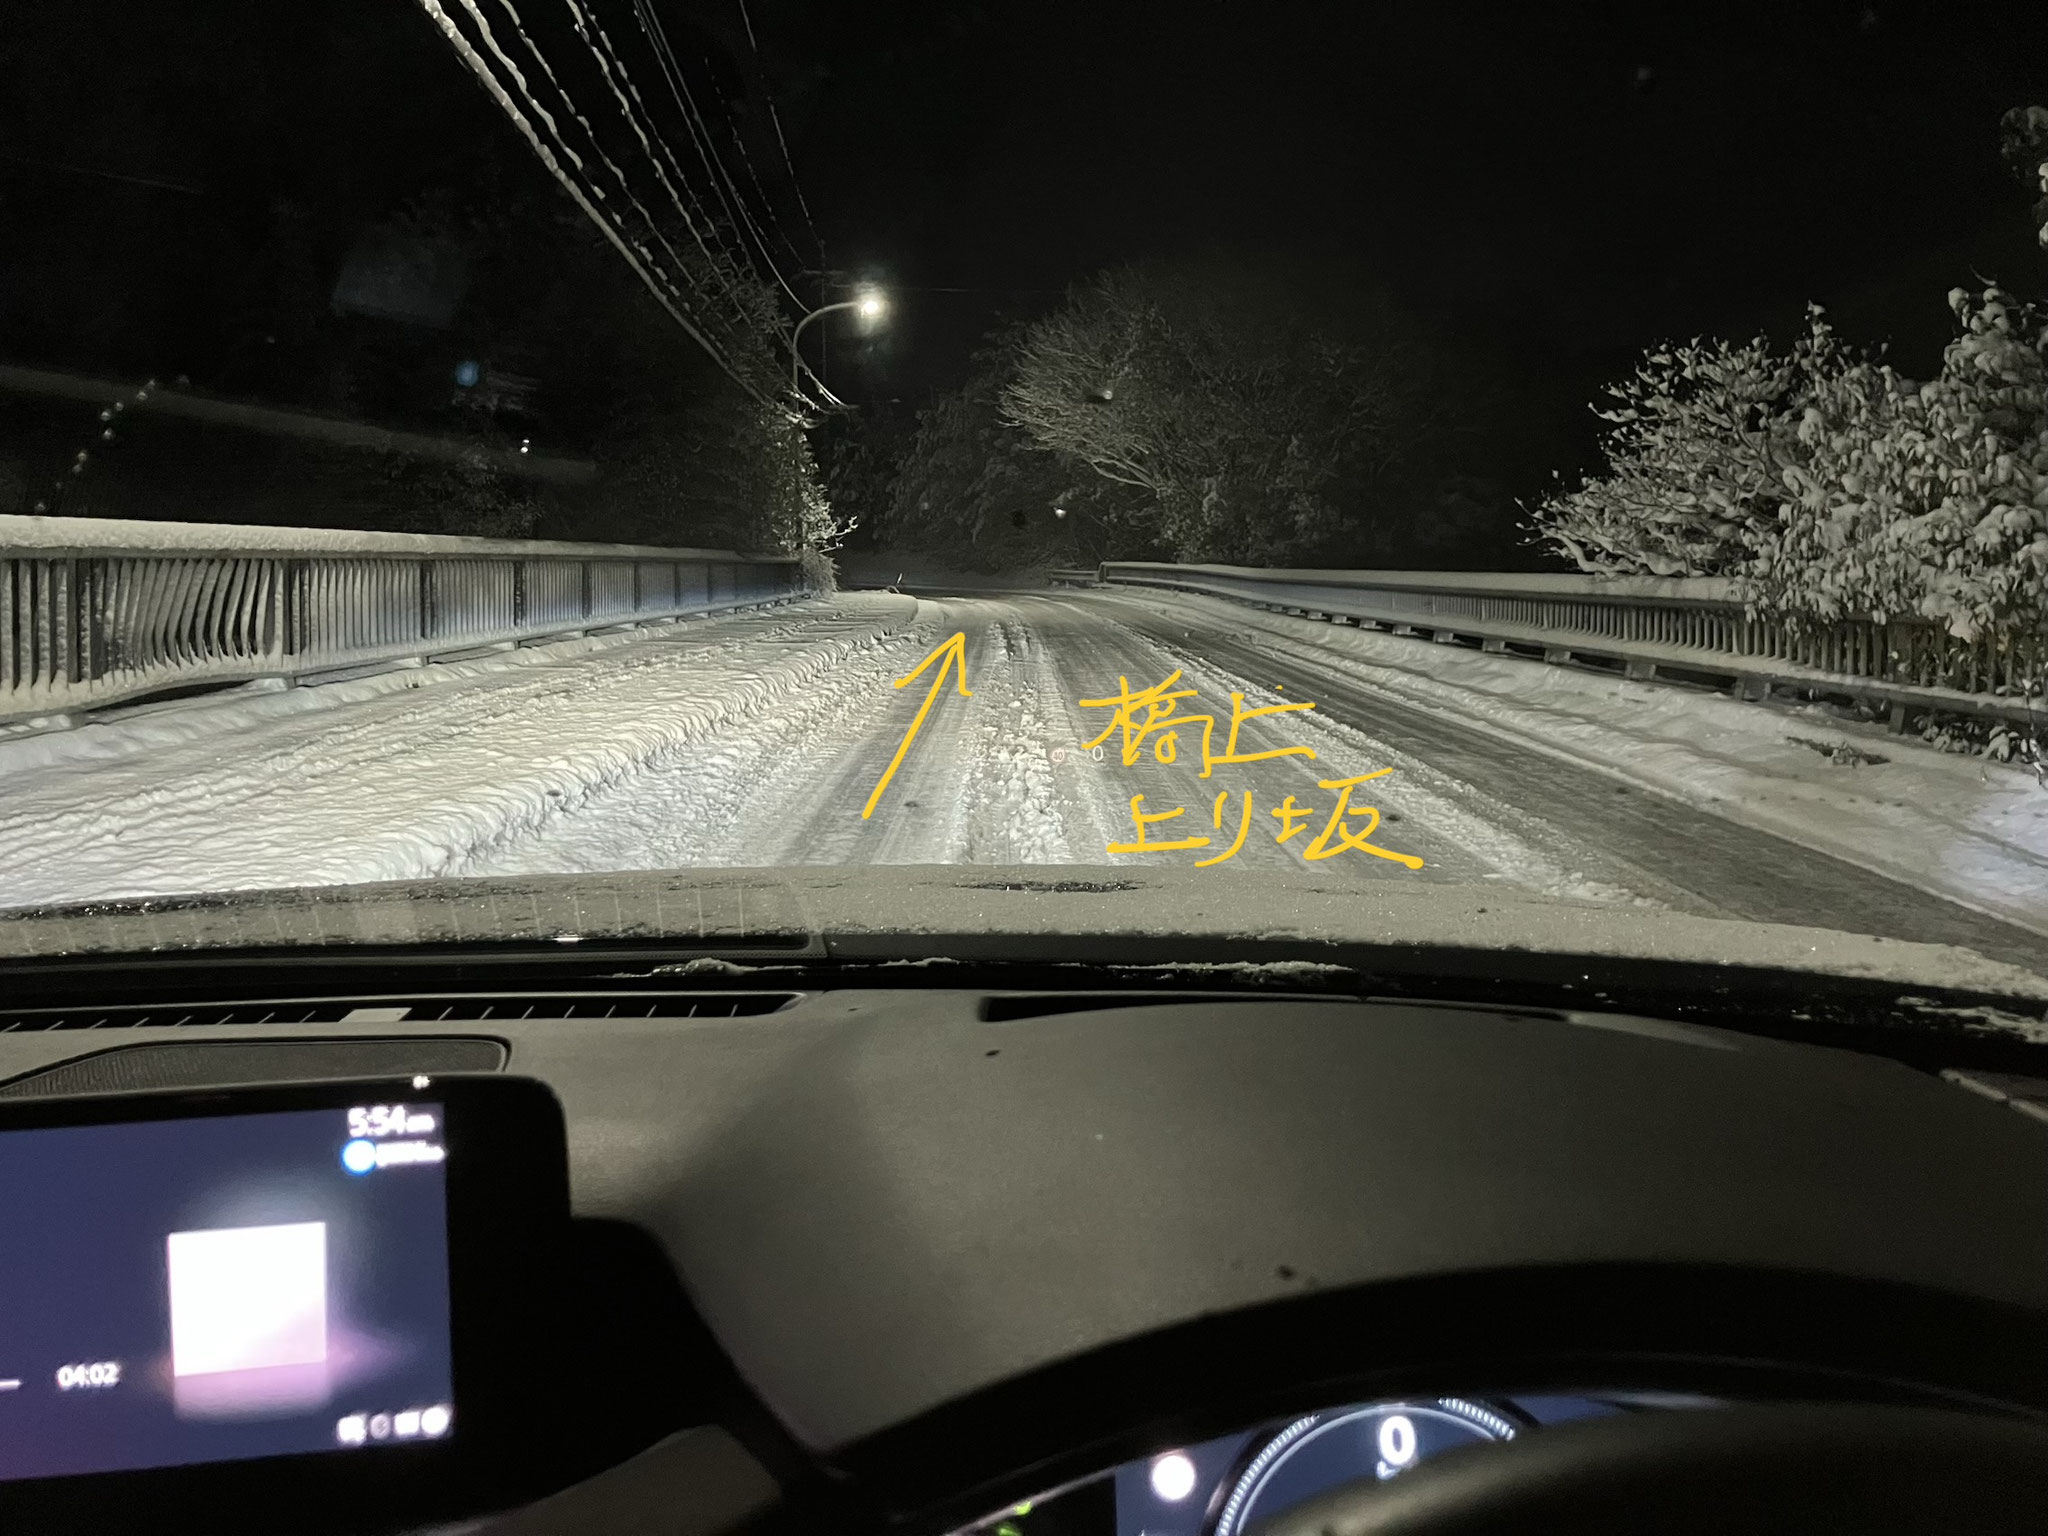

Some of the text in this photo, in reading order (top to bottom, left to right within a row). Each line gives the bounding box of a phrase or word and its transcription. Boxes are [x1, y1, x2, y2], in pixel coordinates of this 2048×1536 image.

[1092, 745, 1104, 762] 0
[57, 1360, 119, 1391] 04:02
[1379, 1415, 1416, 1466] 0
